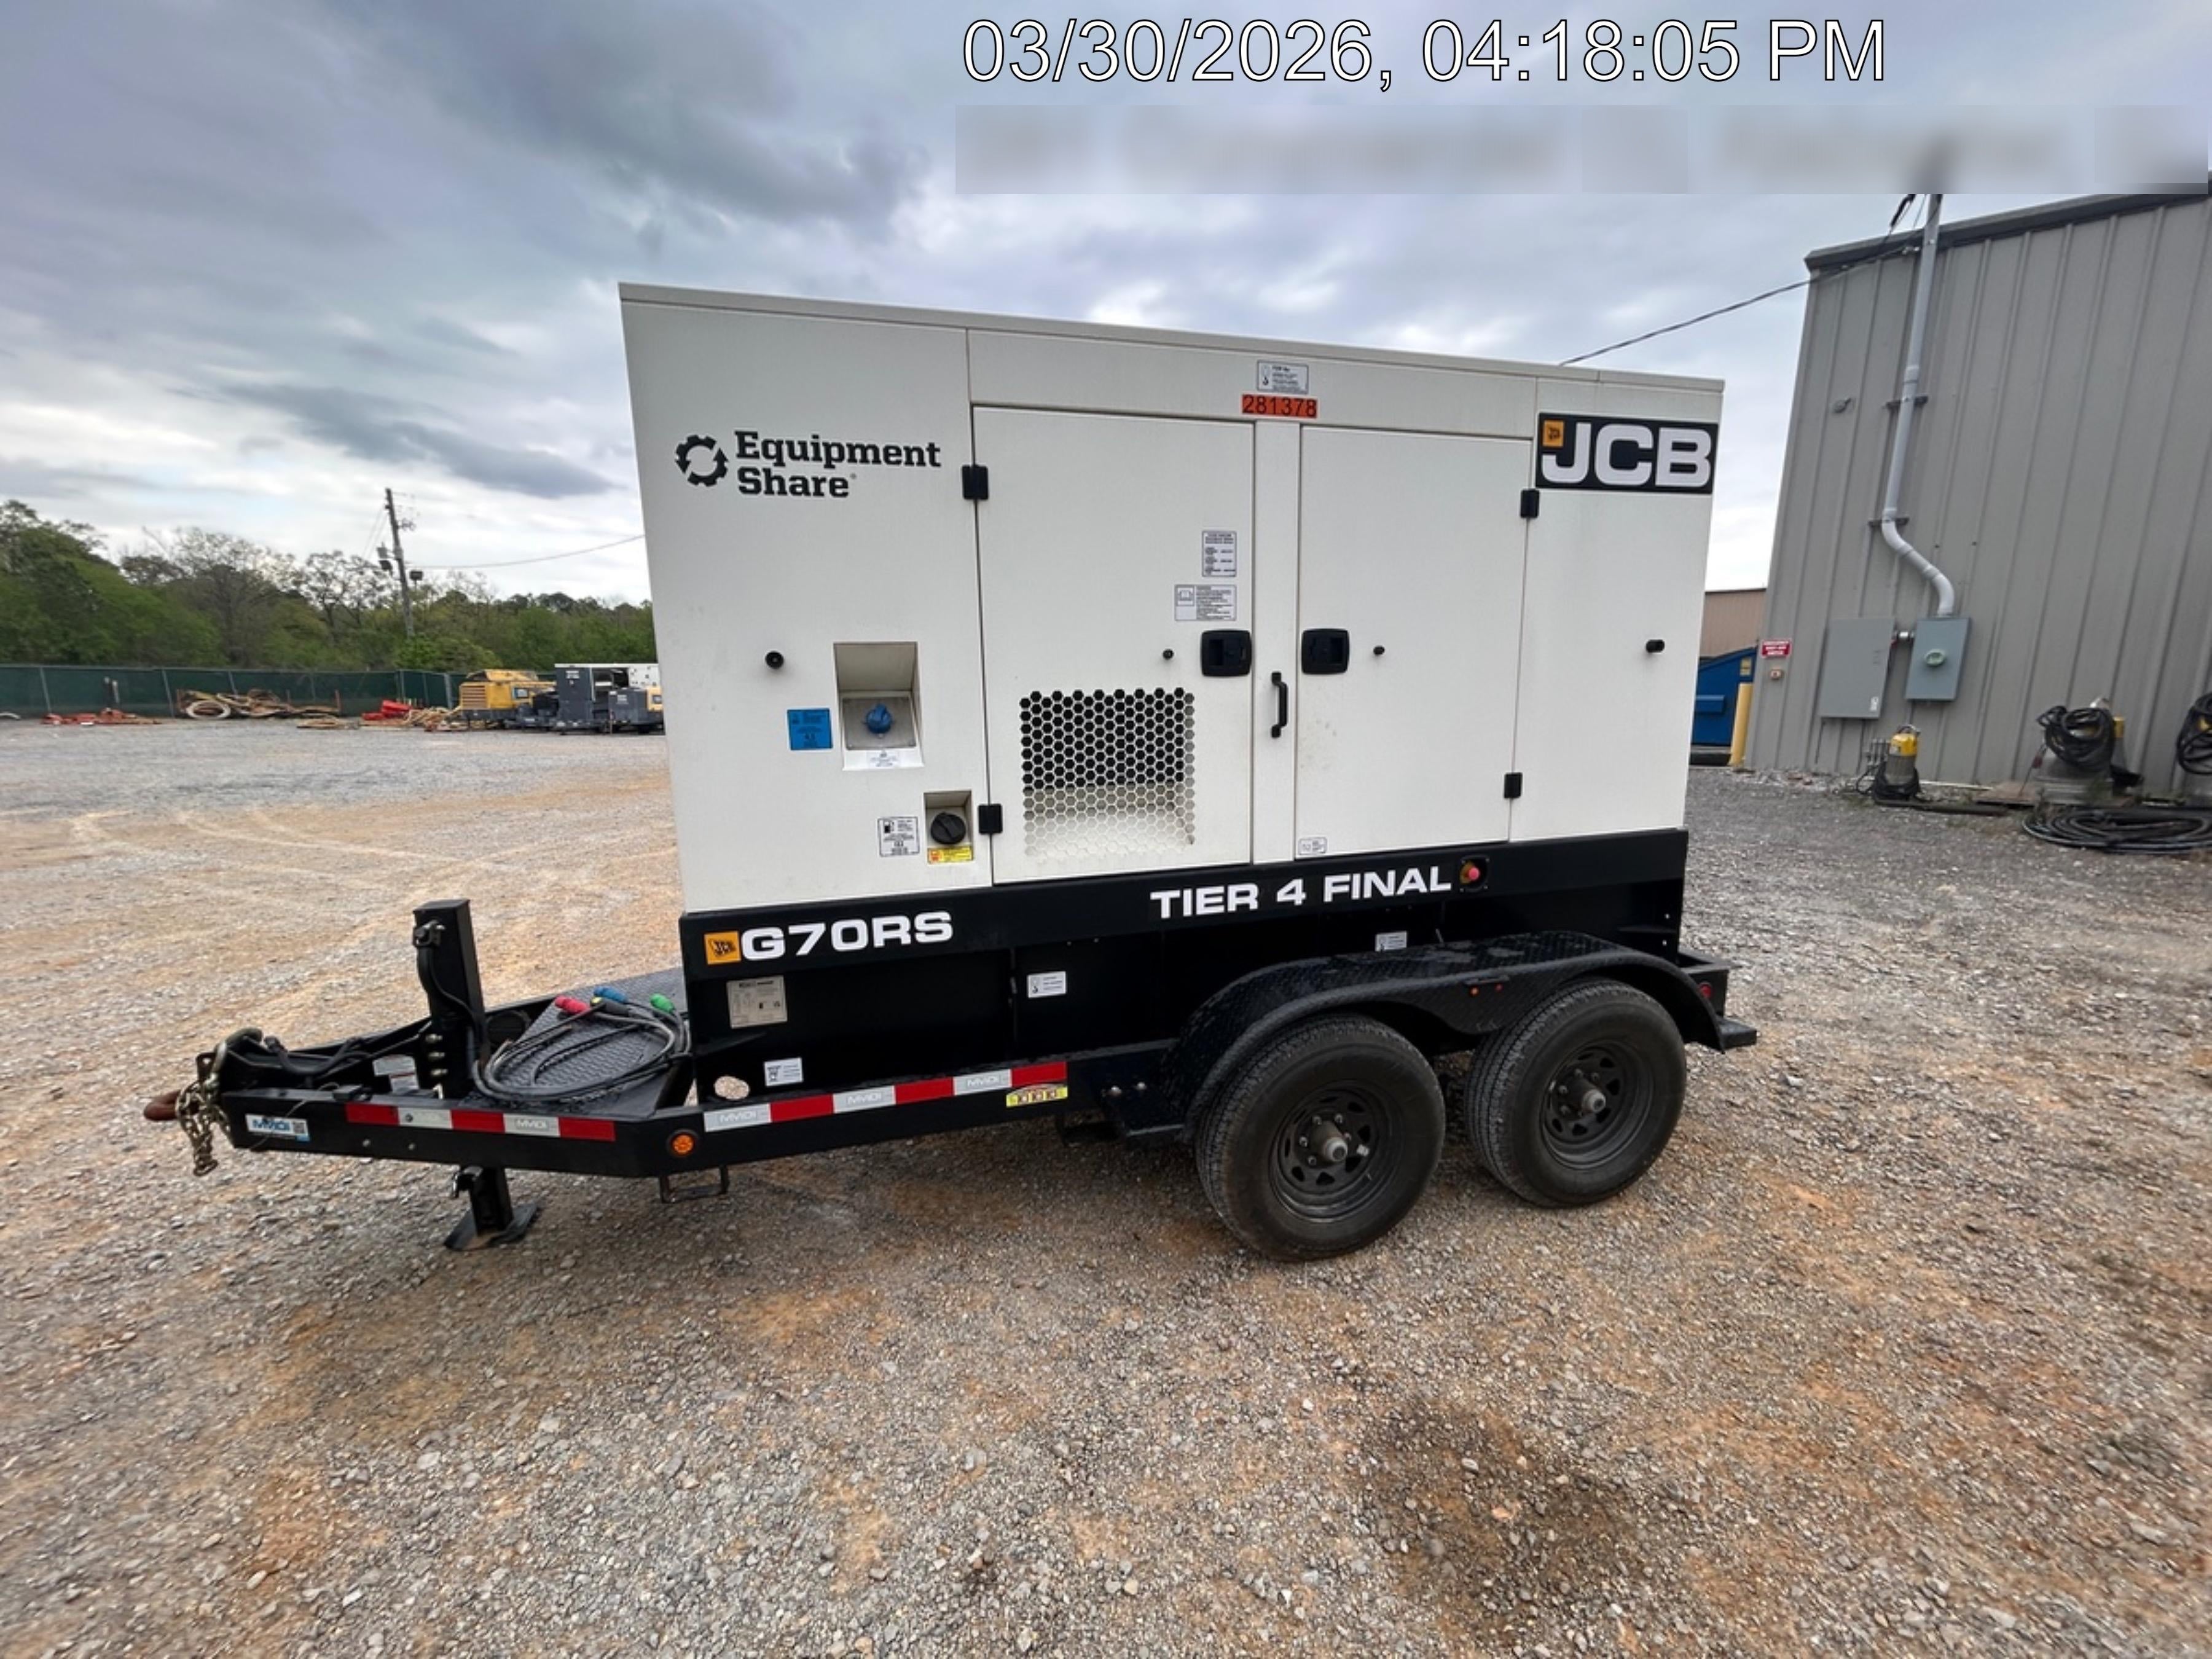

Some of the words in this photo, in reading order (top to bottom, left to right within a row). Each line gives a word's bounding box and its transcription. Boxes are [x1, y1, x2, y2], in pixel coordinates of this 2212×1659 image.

[1242, 394, 1317, 418] 281378
[734, 430, 942, 469] Equipment
[1542, 422, 1712, 487] JCB
[737, 466, 849, 498] Share
[1150, 884, 1259, 919] TIER
[1276, 878, 1306, 906] 4
[1323, 866, 1452, 903] FINAL
[741, 911, 953, 961] G70RS
